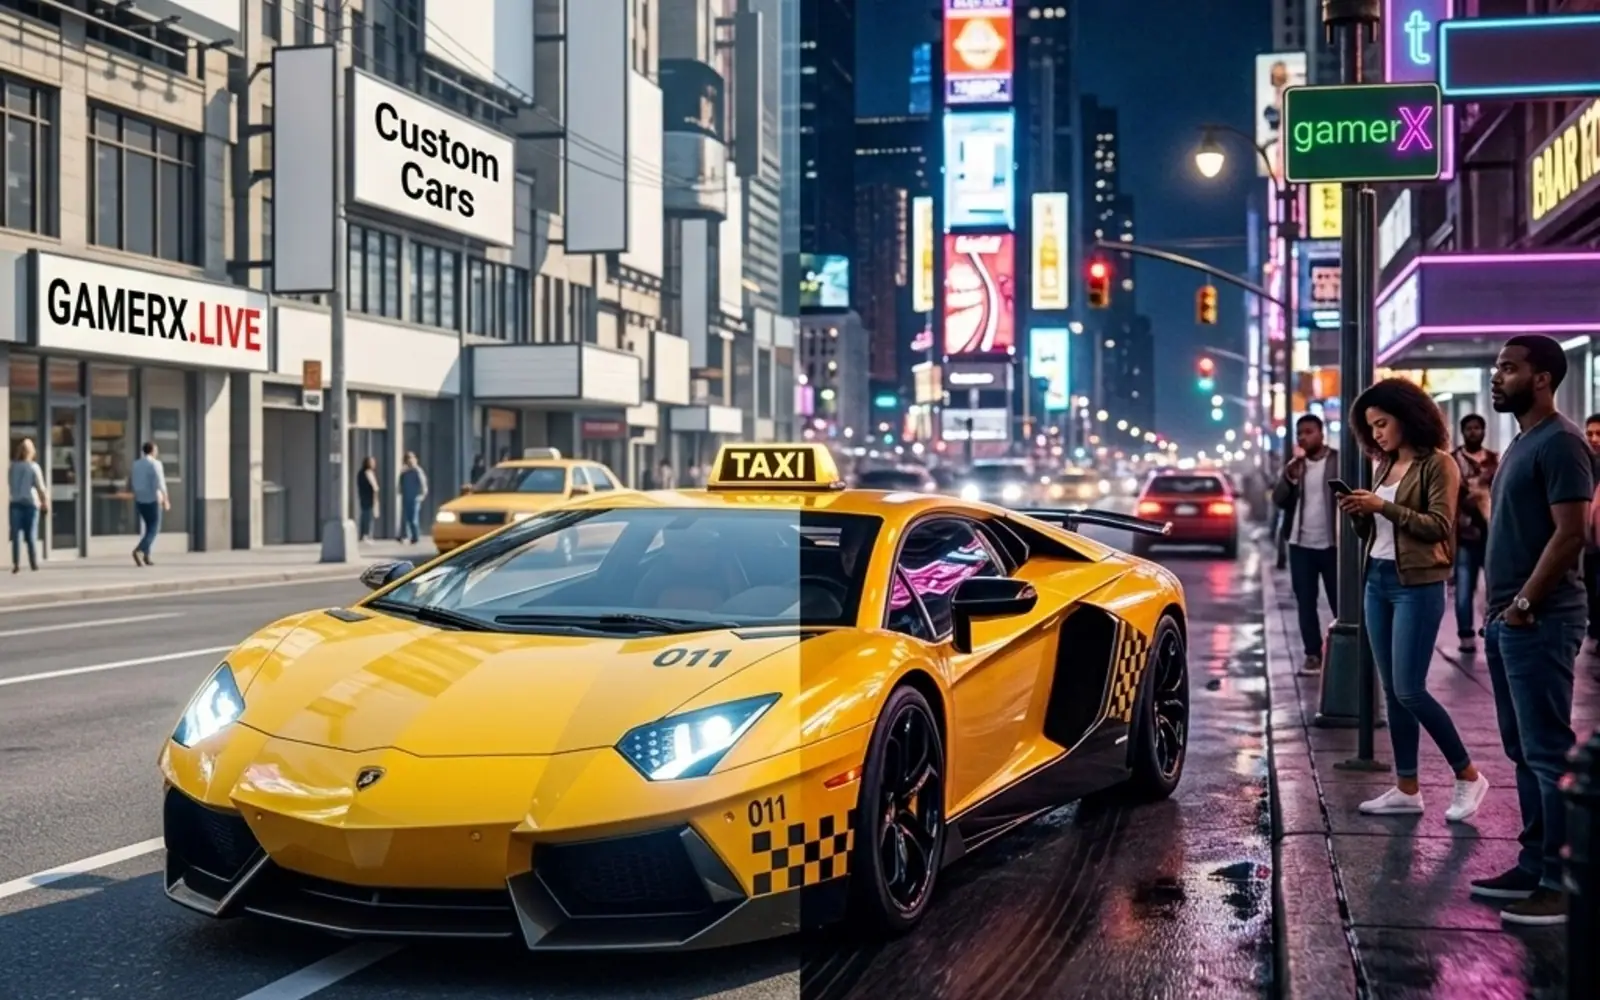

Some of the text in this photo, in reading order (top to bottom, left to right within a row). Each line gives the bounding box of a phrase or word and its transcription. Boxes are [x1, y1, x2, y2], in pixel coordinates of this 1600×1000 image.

[375, 102, 499, 183] Custom
[1293, 106, 1433, 153] gamerX
[401, 161, 475, 218] Cars
[47, 278, 261, 352] GAMERX.LIVE
[730, 451, 805, 479] TAXI
[652, 648, 732, 669] 011
[747, 795, 787, 827] 011
